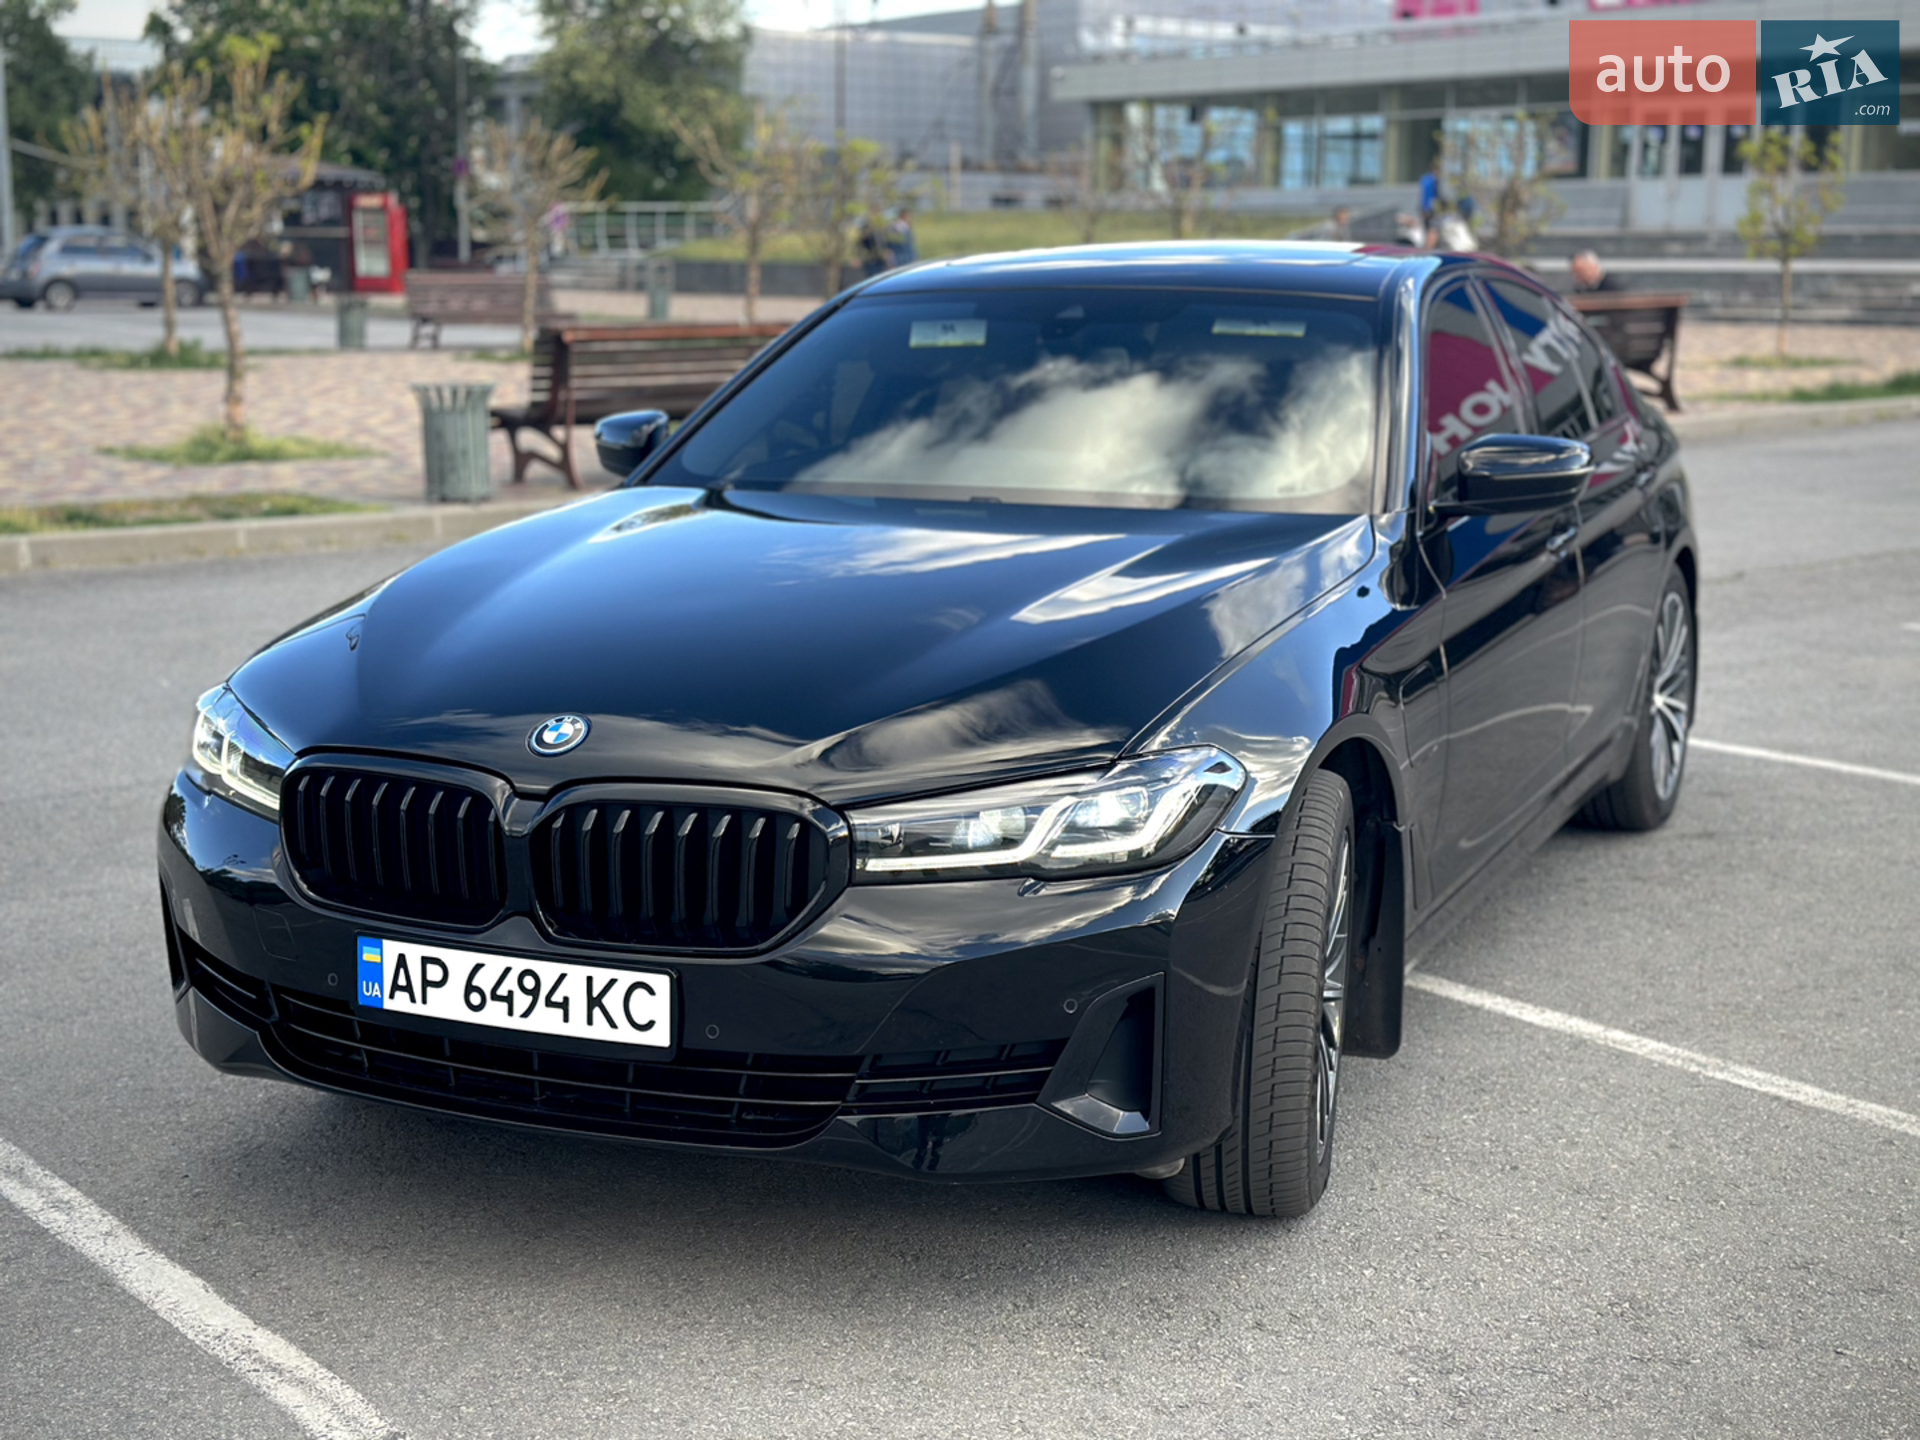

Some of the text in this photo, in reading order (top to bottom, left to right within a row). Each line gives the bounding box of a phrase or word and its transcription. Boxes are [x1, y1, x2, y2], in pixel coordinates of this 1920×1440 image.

[362, 980, 382, 998] UA
[388, 952, 657, 1032] AP 6494 KC
